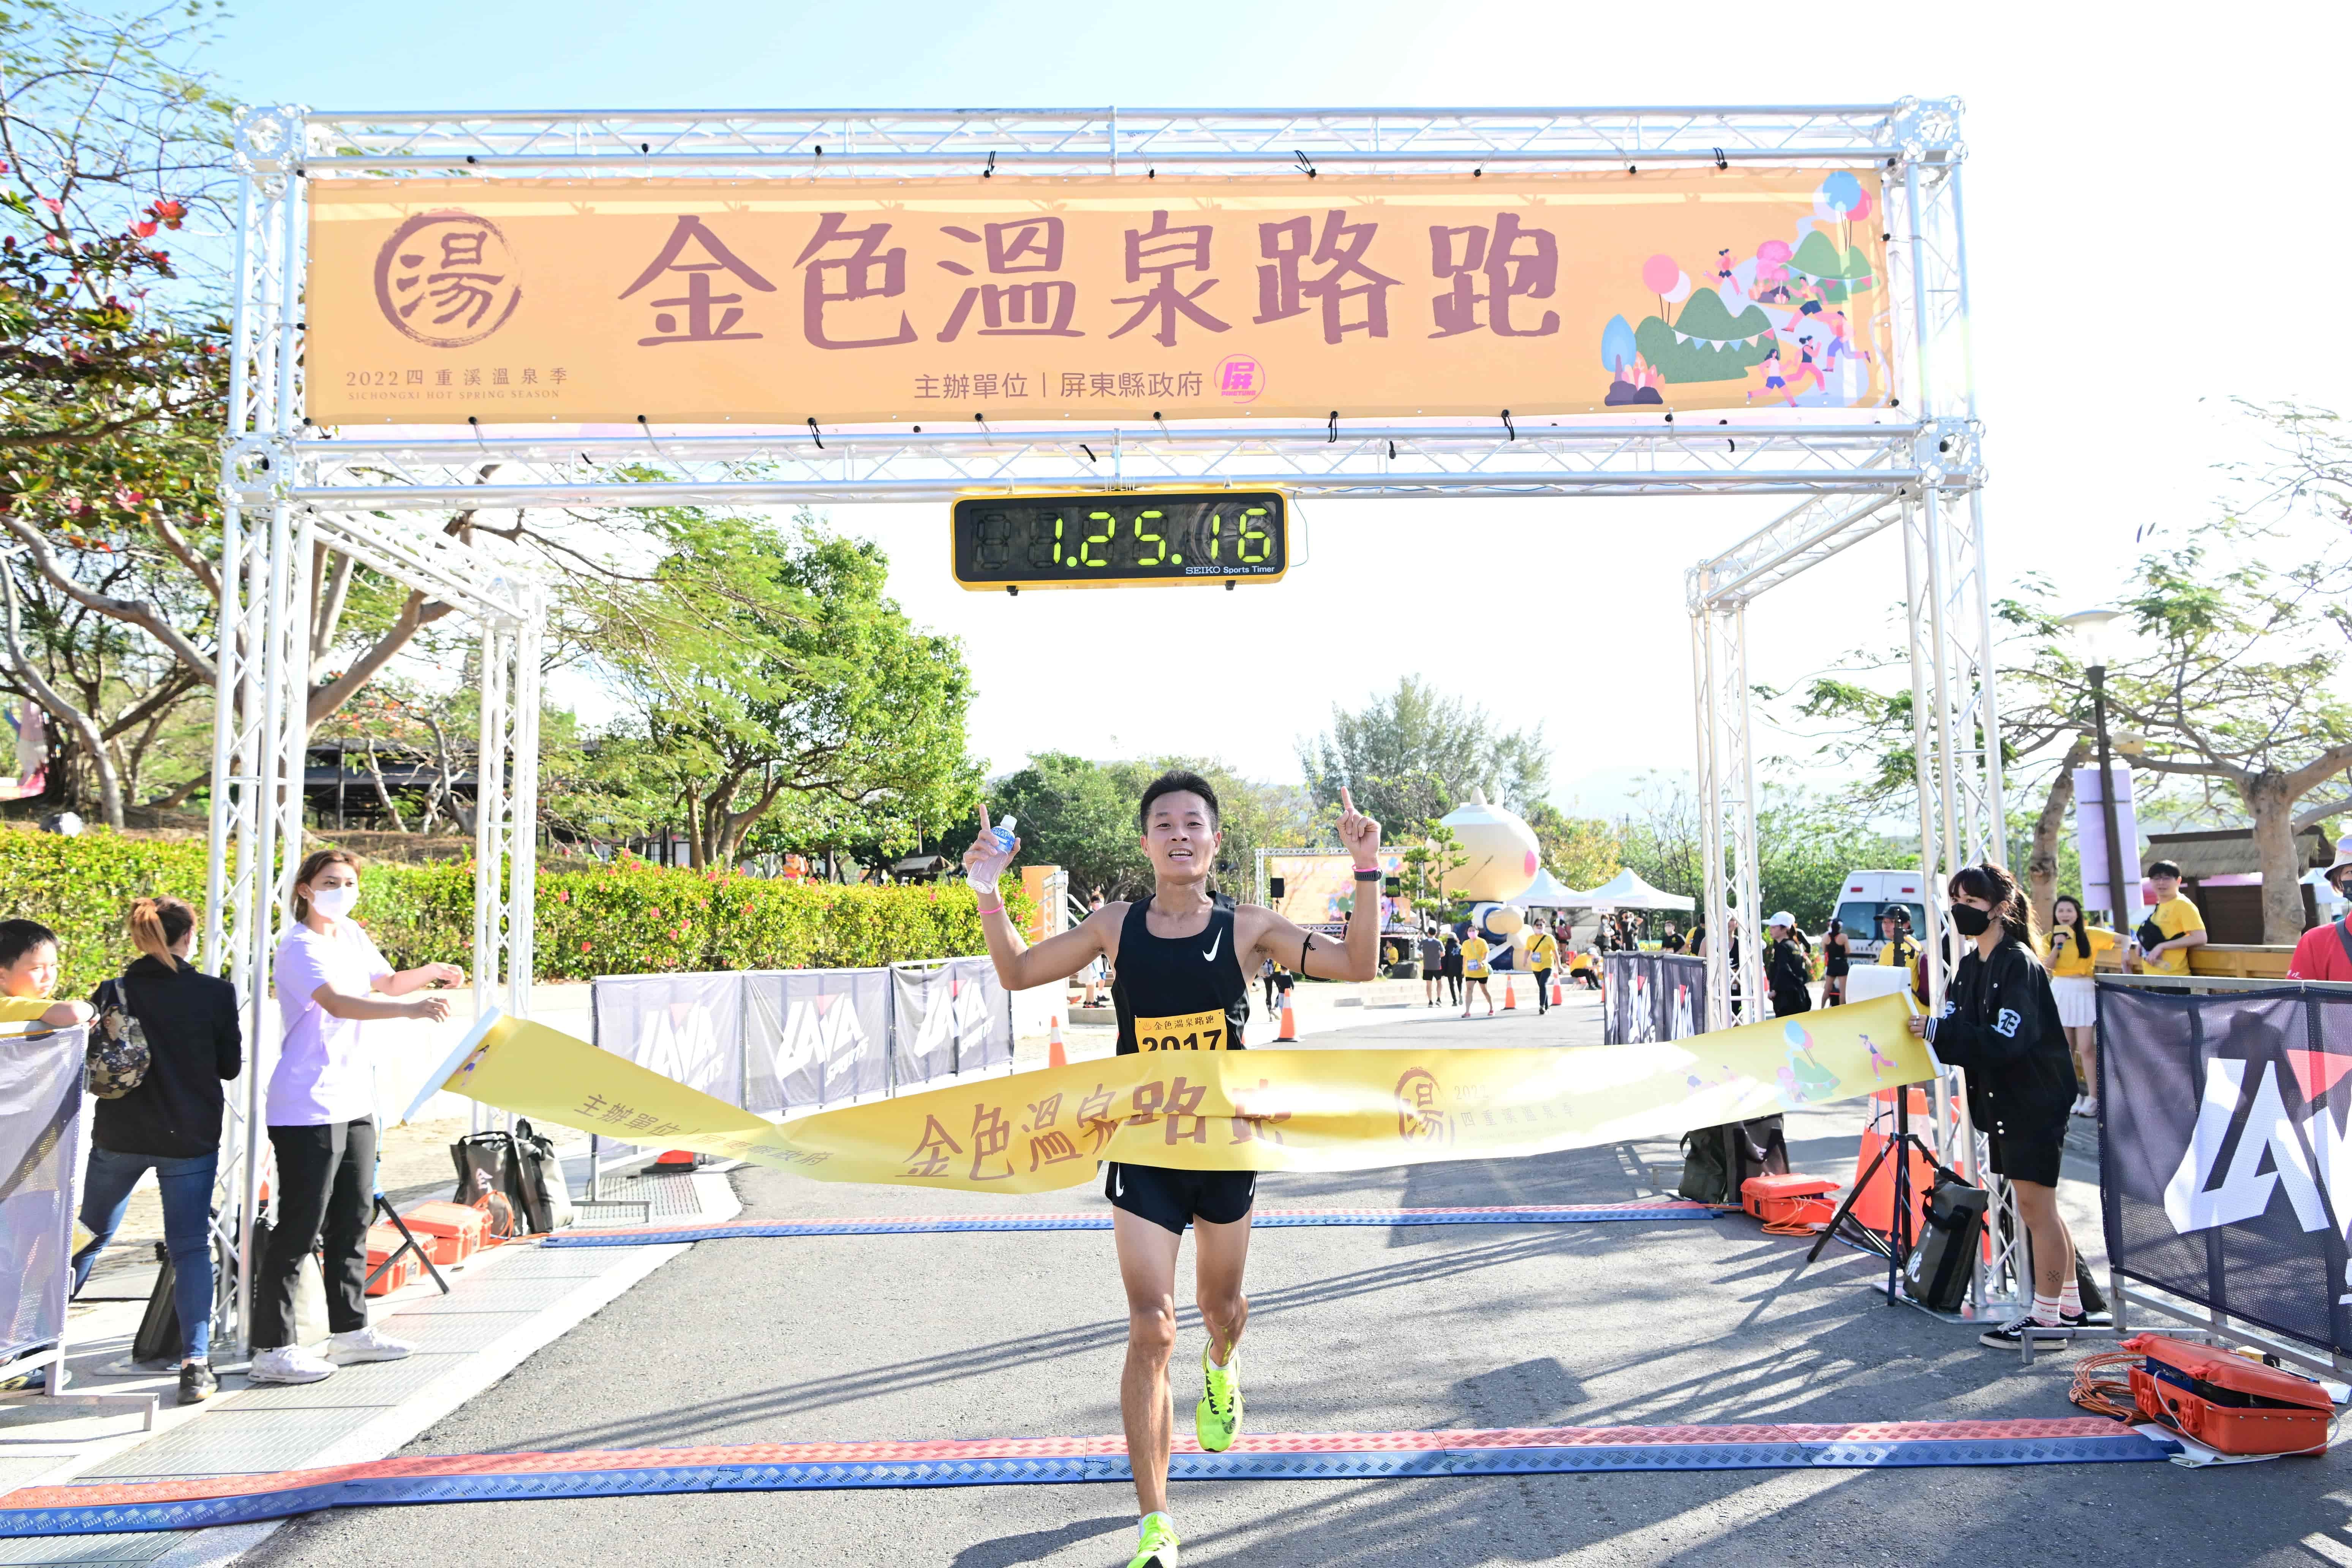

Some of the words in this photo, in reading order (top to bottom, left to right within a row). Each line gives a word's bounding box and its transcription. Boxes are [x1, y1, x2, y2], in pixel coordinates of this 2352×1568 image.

[396, 231, 505, 329] 湯
[618, 212, 1562, 350] 金色溫泉路跑
[348, 391, 419, 400] SICHONGXI
[427, 390, 453, 399] HOT
[459, 390, 504, 399] SPRING
[511, 389, 560, 398] SEASON
[1185, 566, 1220, 575] SEIKO
[1223, 566, 1250, 574] Sports
[1154, 1015, 1214, 1031] 金色溫泉路跑
[1142, 1029, 1222, 1052] 2017
[2164, 1057, 2352, 1241] LAV
